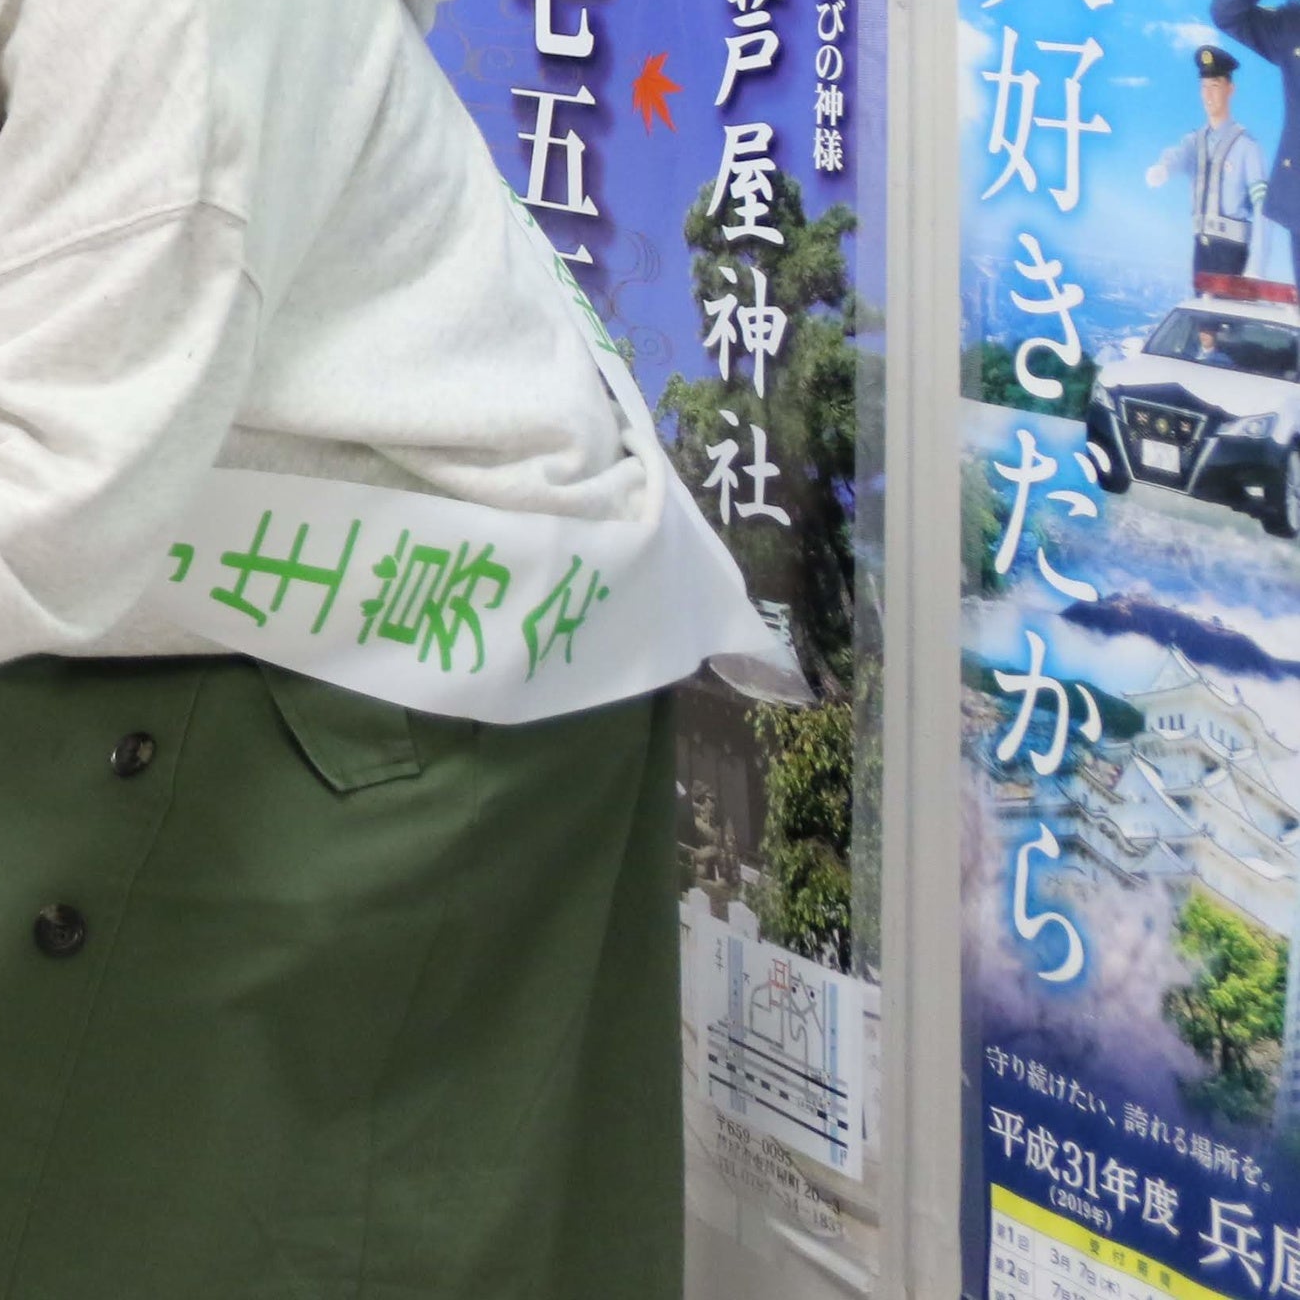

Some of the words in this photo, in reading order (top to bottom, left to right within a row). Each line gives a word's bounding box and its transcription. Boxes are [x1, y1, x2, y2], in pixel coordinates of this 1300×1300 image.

[167, 508, 614, 685] 生募金
[984, 1044, 1273, 1194] 守り続けたい、誇れる場所を。
[987, 1104, 1181, 1237] 平成31年度
